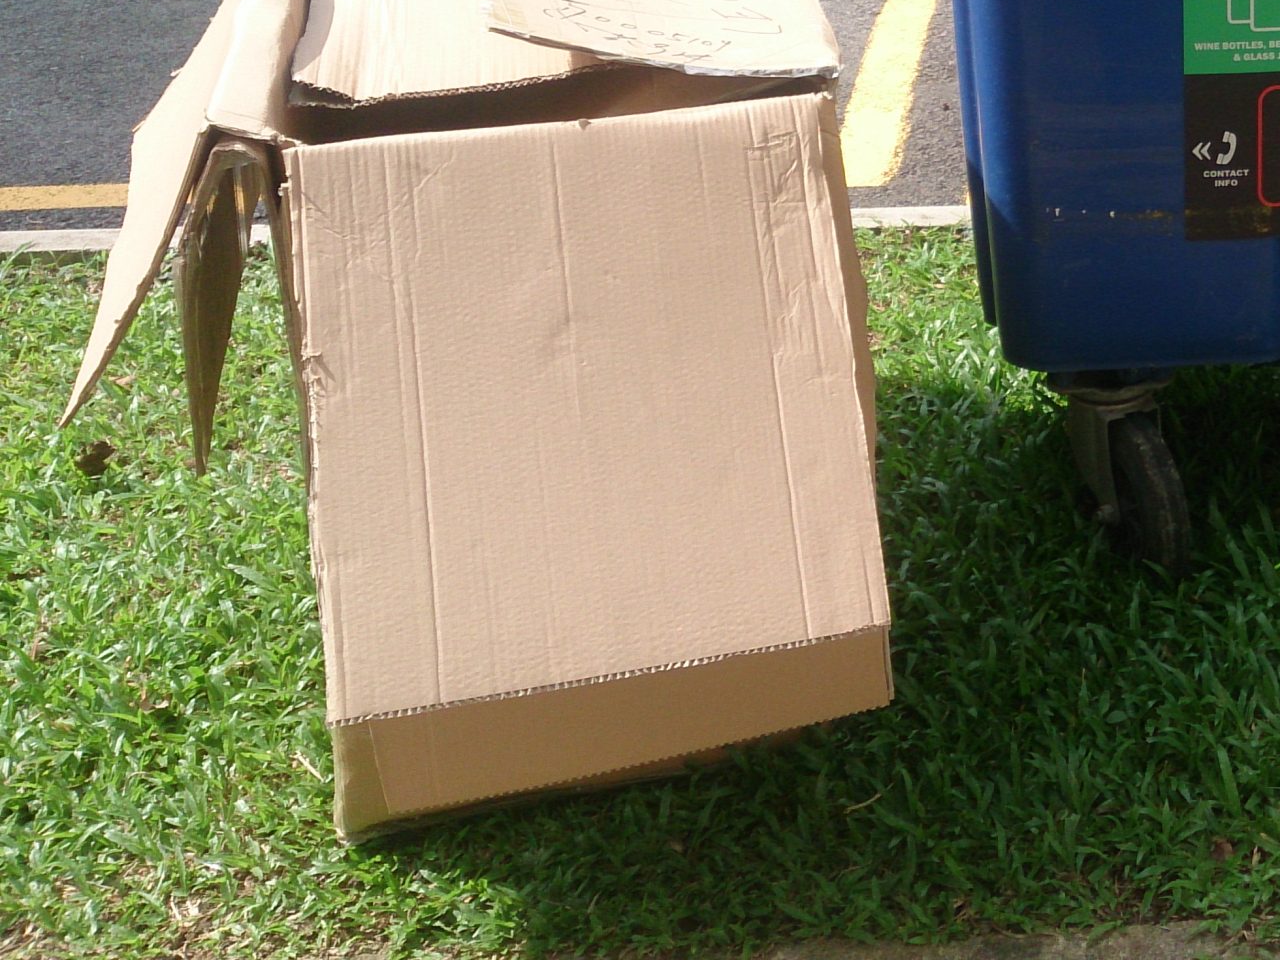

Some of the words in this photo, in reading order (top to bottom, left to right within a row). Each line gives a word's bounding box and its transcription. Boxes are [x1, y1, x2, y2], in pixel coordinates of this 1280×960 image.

[1194, 42, 1220, 50] WINE
[1222, 41, 1266, 50] BOTTLES,
[1233, 53, 1241, 61] &
[1243, 52, 1275, 61] GLASS
[1203, 169, 1250, 178] CONTACT
[1214, 179, 1238, 187] INFO
